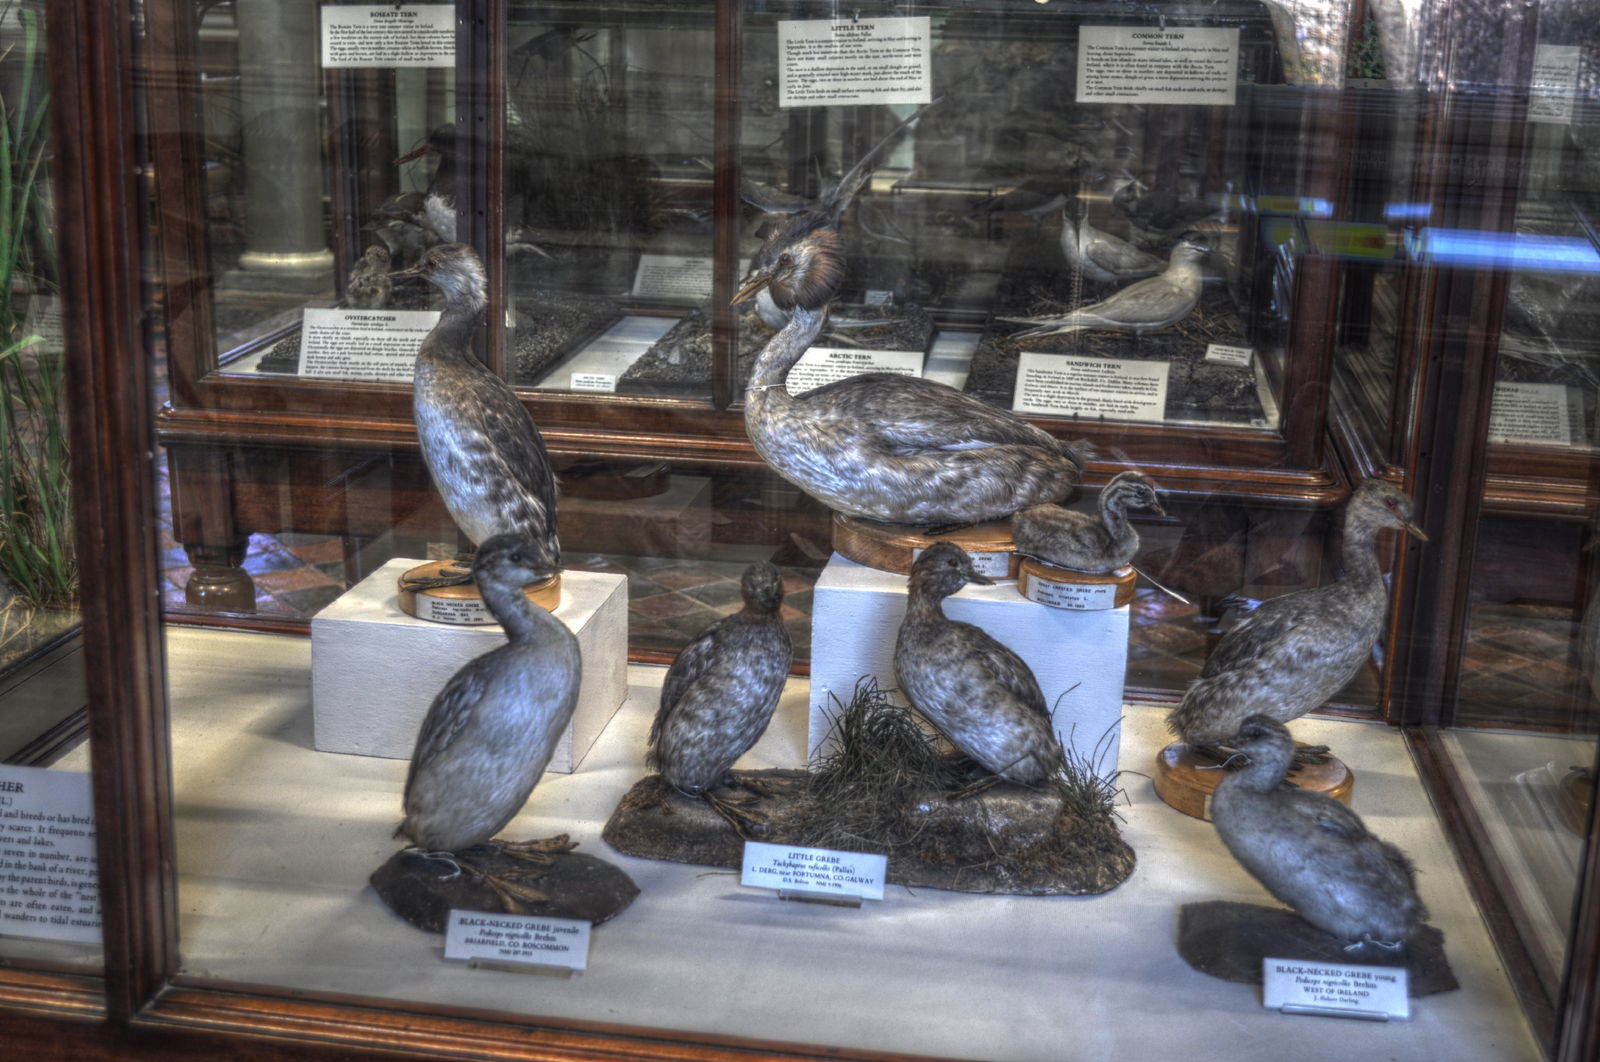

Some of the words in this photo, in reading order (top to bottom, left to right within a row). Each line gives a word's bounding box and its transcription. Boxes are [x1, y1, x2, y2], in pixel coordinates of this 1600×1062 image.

[1066, 360, 1102, 368] SANDWICH
[4, 808, 18, 818] and
[20, 810, 46, 822] breeds
[57, 813, 70, 823] has
[72, 814, 90, 824] bred
[8, 824, 35, 833] scarce.
[38, 825, 46, 834] It
[48, 825, 86, 838] frequents
[17, 836, 32, 845] and
[33, 836, 55, 846] lakes.
[4, 849, 25, 858] seven
[28, 849, 36, 858] in
[39, 851, 72, 862] number,
[788, 852, 814, 861] LITTLE
[816, 855, 841, 864] GREBE
[4, 860, 13, 868] in
[14, 860, 27, 870] the
[28, 861, 46, 872] bank
[48, 864, 59, 872] of
[66, 867, 88, 876] river,
[832, 864, 856, 875] (Pallas)
[8, 872, 20, 882] the
[20, 876, 47, 885] parent
[48, 876, 70, 887] birds,
[844, 876, 874, 885] GALWAY
[6, 884, 18, 895] the
[22, 887, 46, 897] whole
[48, 888, 58, 898] of
[60, 890, 72, 900] the
[26, 900, 47, 910] often
[50, 904, 74, 913] eaten,
[78, 904, 94, 914] and
[4, 912, 36, 922] wanders
[40, 915, 48, 923] to
[50, 916, 69, 925] tidal
[460, 918, 522, 930] BLACK-NECKED
[524, 922, 552, 932] GREBE
[552, 926, 580, 935] juvenile
[522, 942, 570, 952] ROSCOMMON
[1276, 966, 1342, 978] BLACK-NECKED
[1344, 970, 1372, 980] GREBE
[1374, 974, 1396, 984] young
[1353, 980, 1377, 989] Brehm
[1304, 986, 1323, 994] WEST
[1337, 988, 1370, 998] IRELAND
